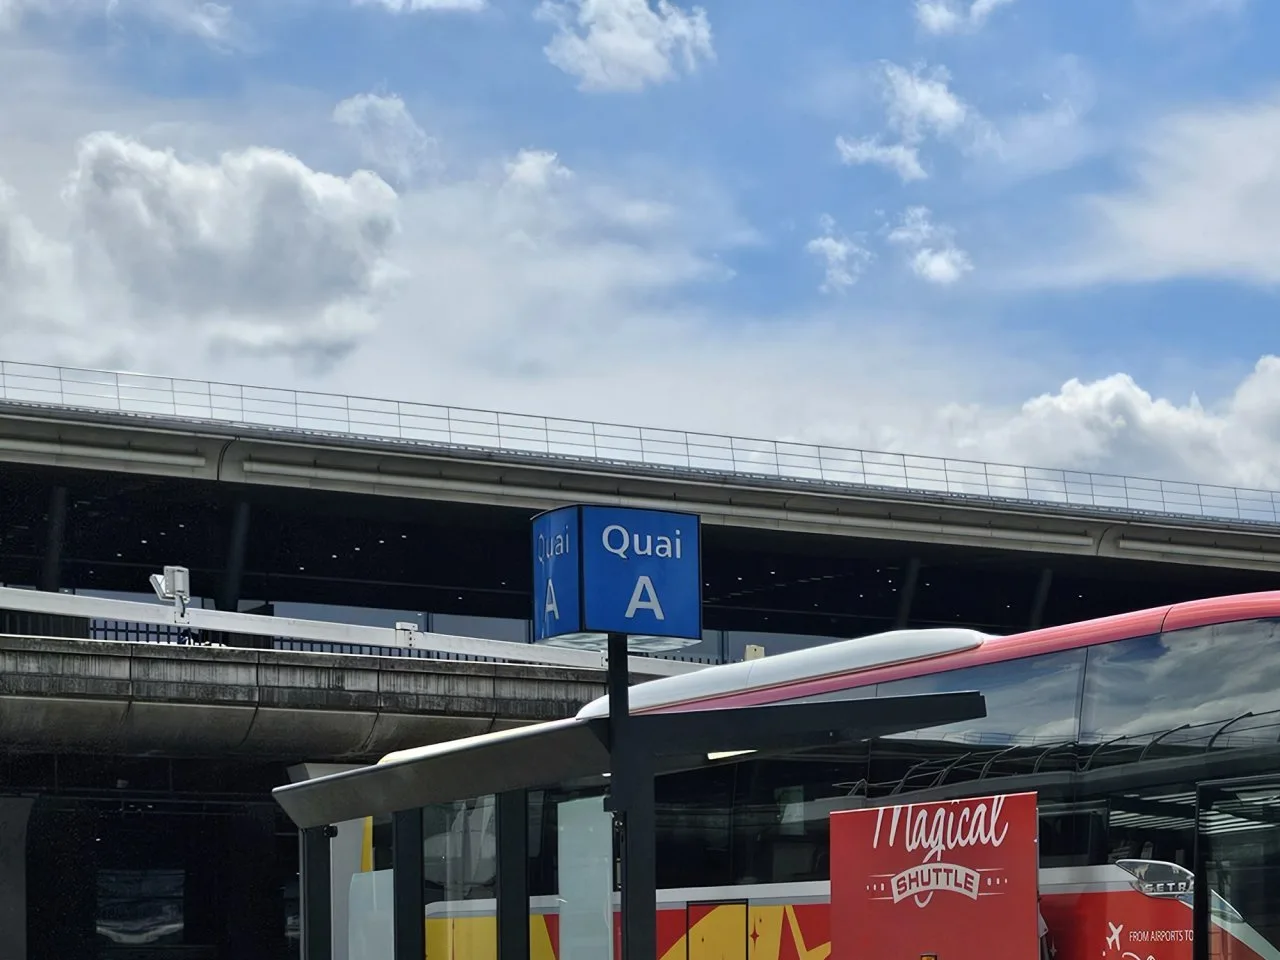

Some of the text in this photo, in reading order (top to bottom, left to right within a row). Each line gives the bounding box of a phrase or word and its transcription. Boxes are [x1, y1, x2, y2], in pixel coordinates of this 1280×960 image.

[538, 525, 569, 565] Quai
[602, 525, 682, 559] Quai
[544, 578, 560, 622] A
[626, 575, 665, 621] A
[873, 796, 1009, 868] Magical
[896, 867, 976, 896] SHUTTLE
[1129, 930, 1194, 942] FROM AIRPORTS TO
